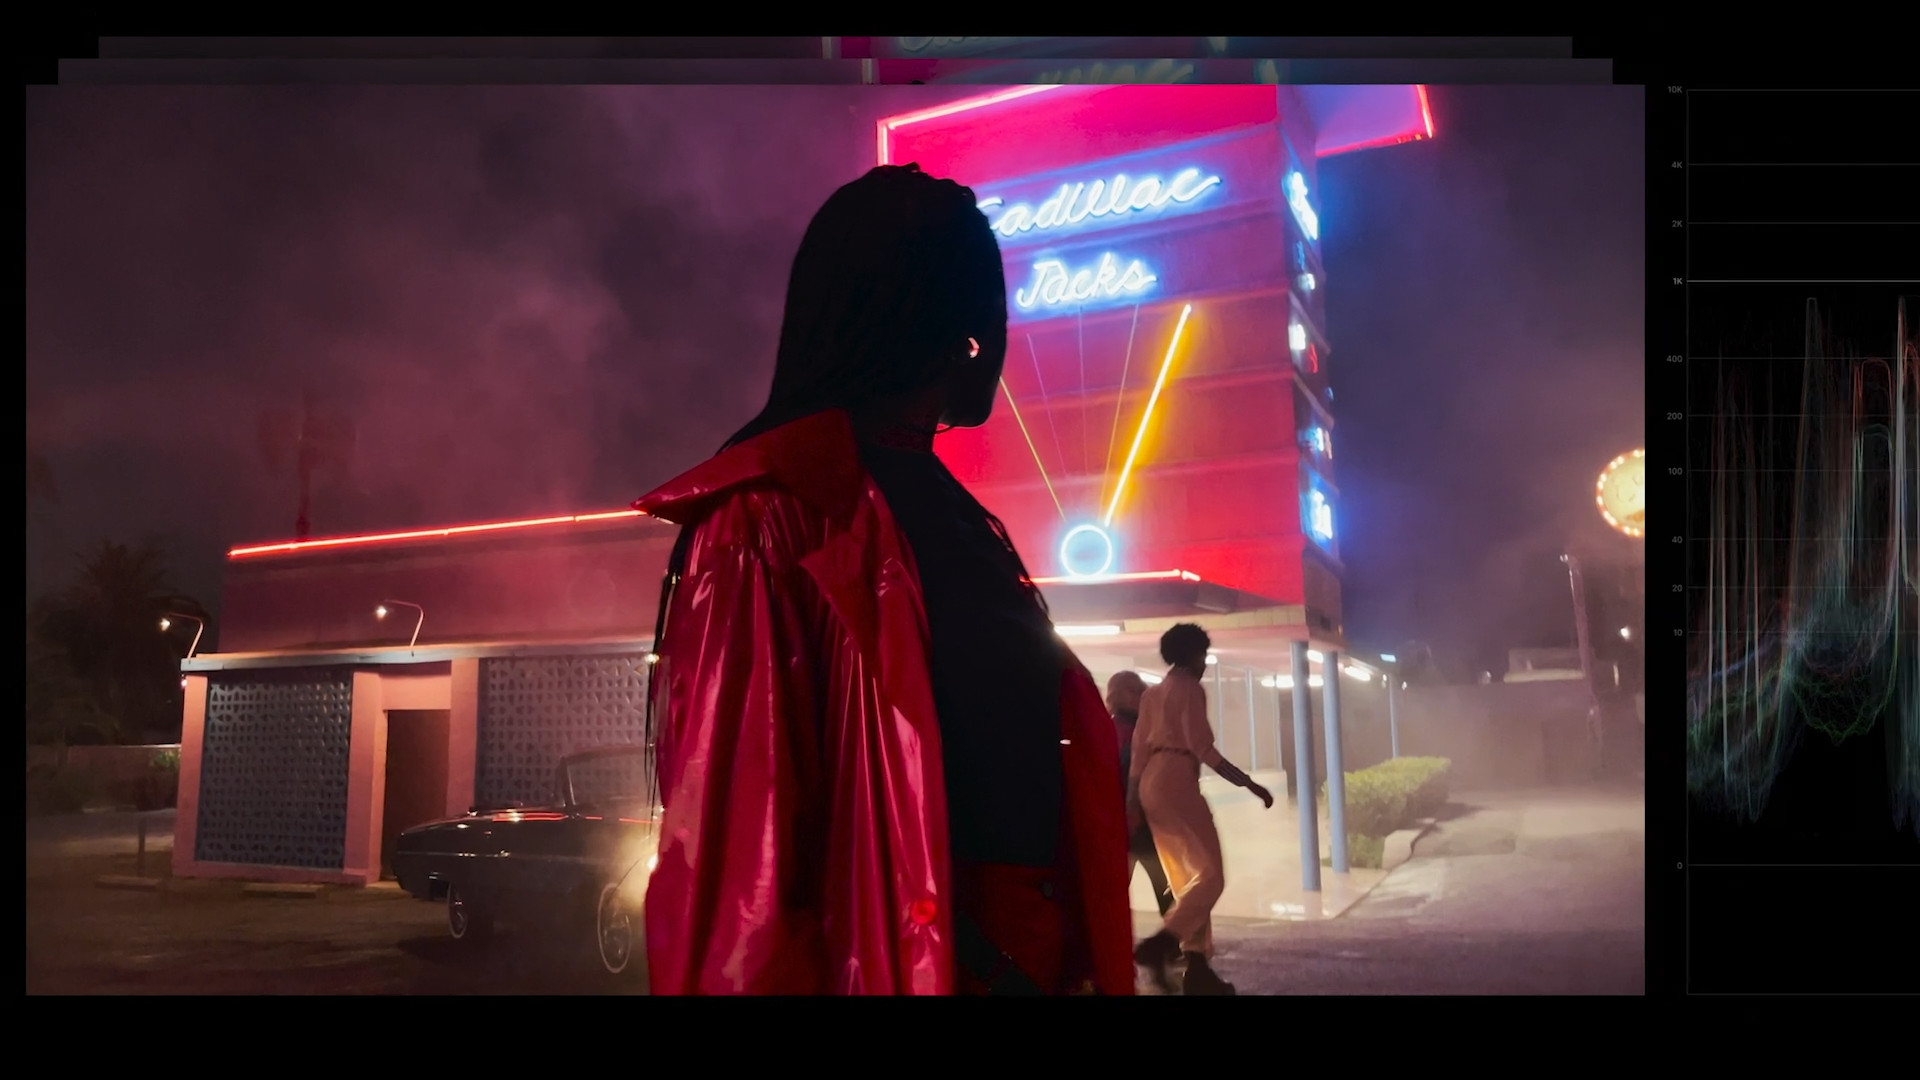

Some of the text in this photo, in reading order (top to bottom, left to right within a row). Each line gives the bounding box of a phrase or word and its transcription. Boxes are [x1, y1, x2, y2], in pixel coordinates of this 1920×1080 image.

[1017, 252, 1157, 307] Jacks
[1673, 277, 1682, 285] 1K
[1667, 412, 1682, 420] 200
[1668, 467, 1682, 475] 100
[1672, 584, 1682, 592] 20
